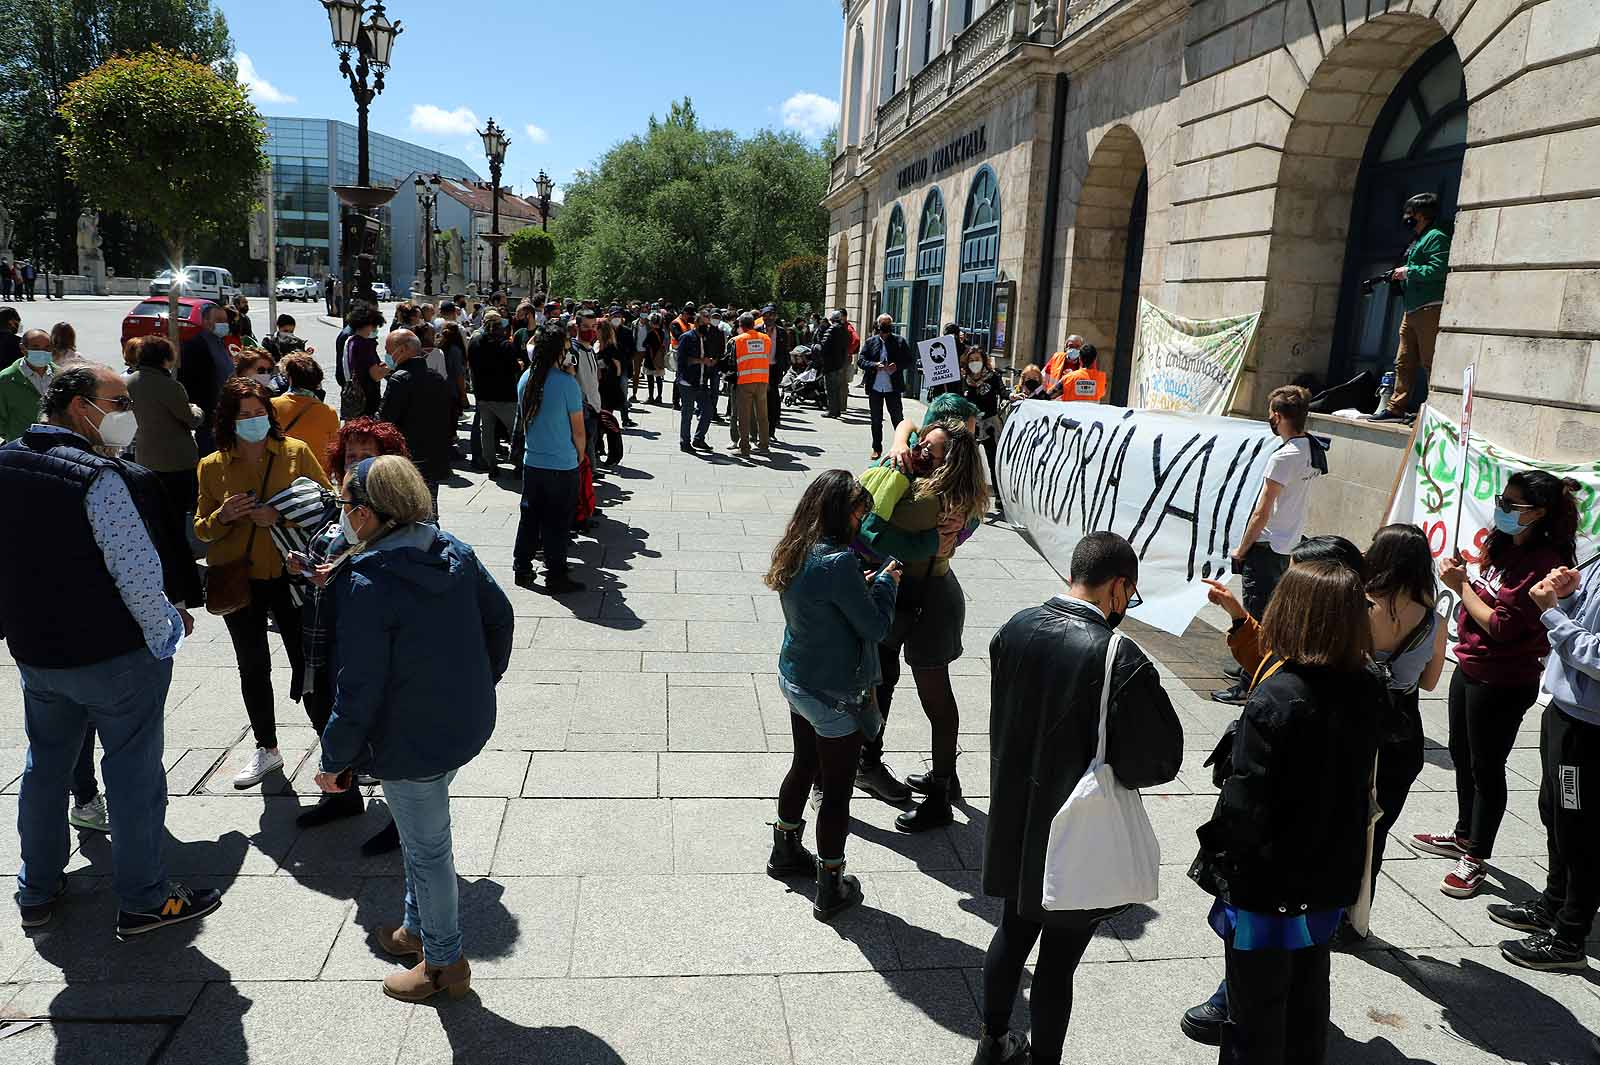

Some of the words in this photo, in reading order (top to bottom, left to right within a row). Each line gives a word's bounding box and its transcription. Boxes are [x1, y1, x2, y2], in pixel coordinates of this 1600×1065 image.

[932, 373, 953, 381] GRANJAS
[1564, 770, 1574, 795] PUMA
[160, 897, 185, 916] N
